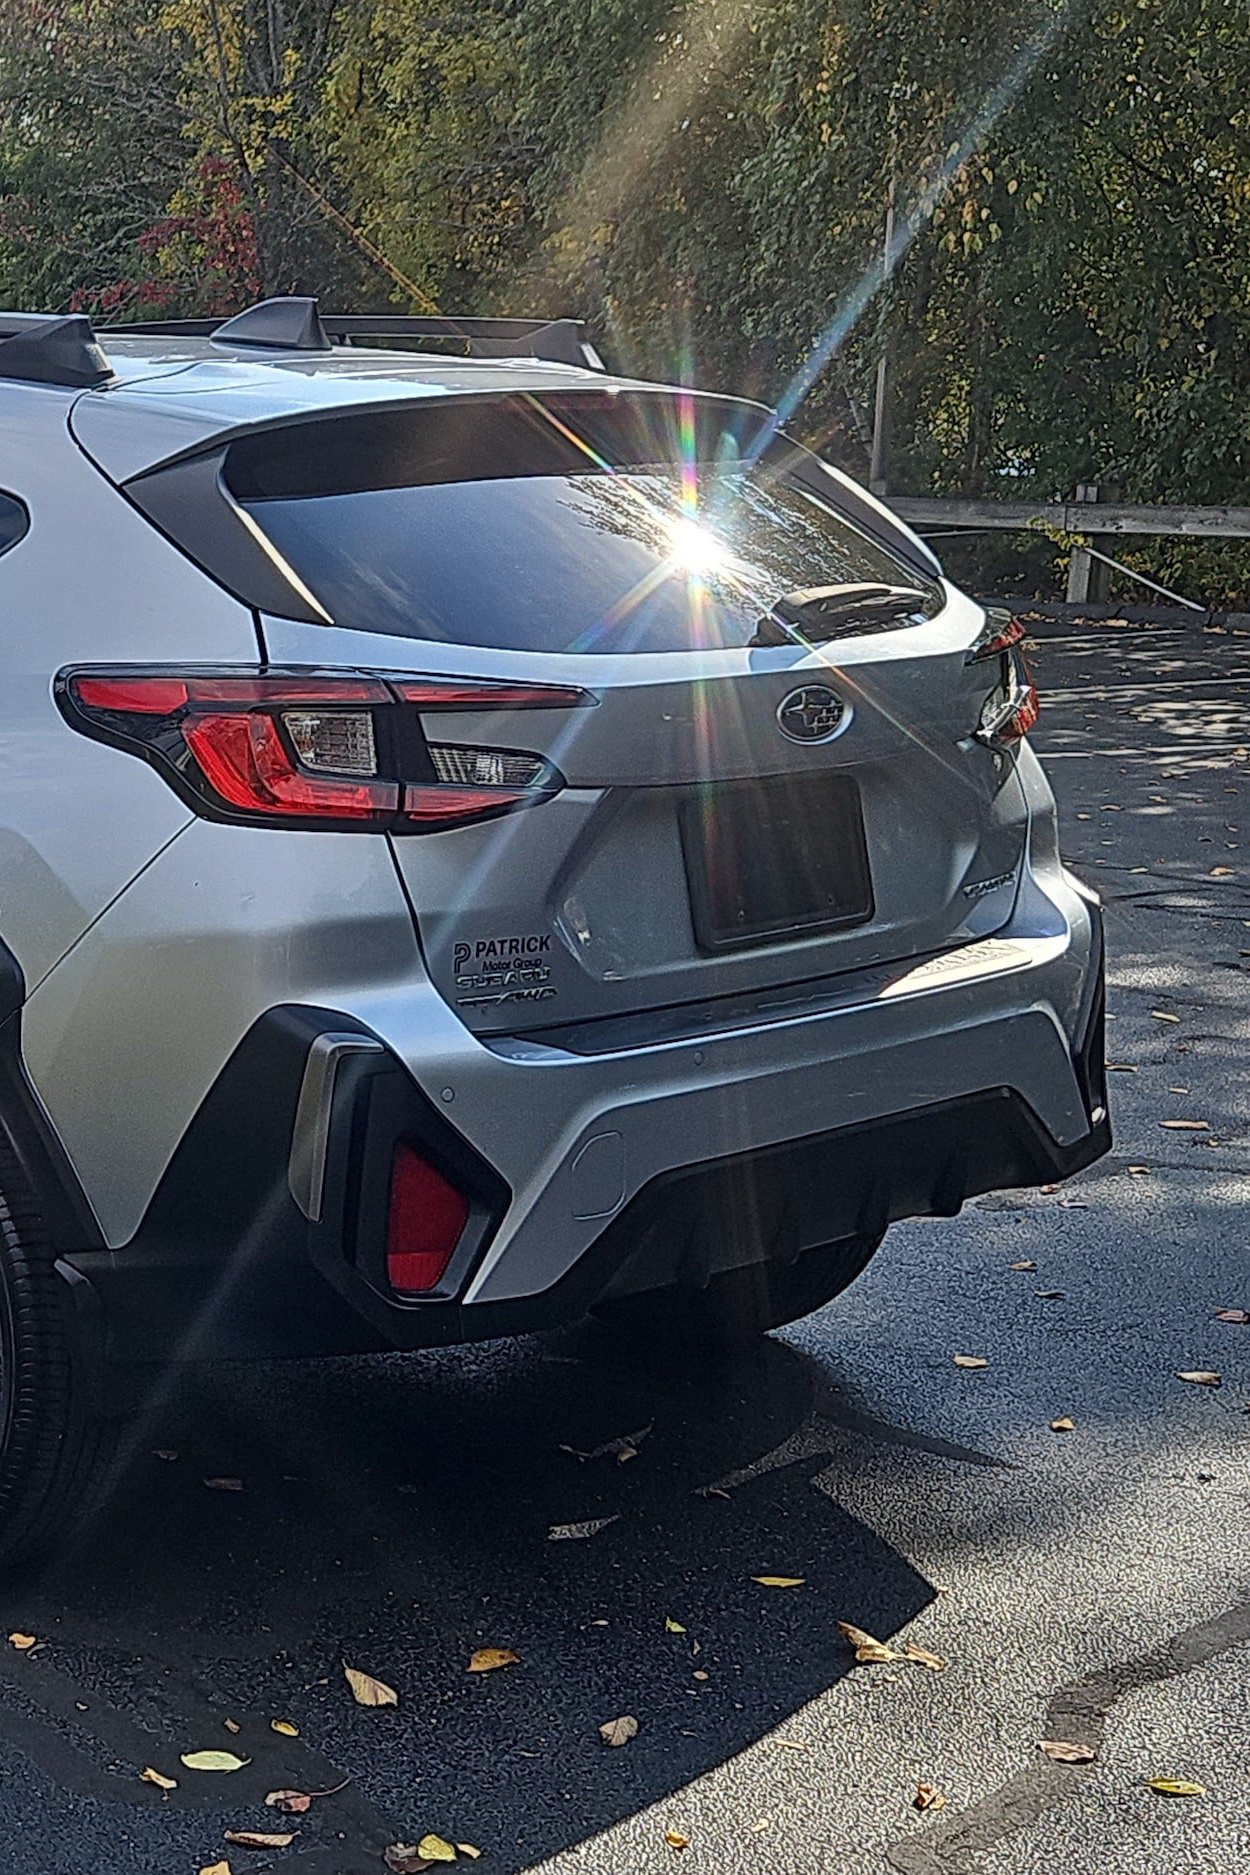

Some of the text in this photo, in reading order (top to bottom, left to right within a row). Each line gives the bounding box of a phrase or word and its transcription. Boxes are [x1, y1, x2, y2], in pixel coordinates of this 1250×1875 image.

[475, 935, 551, 958] PATRICK
[482, 957, 543, 972] Motor Group
